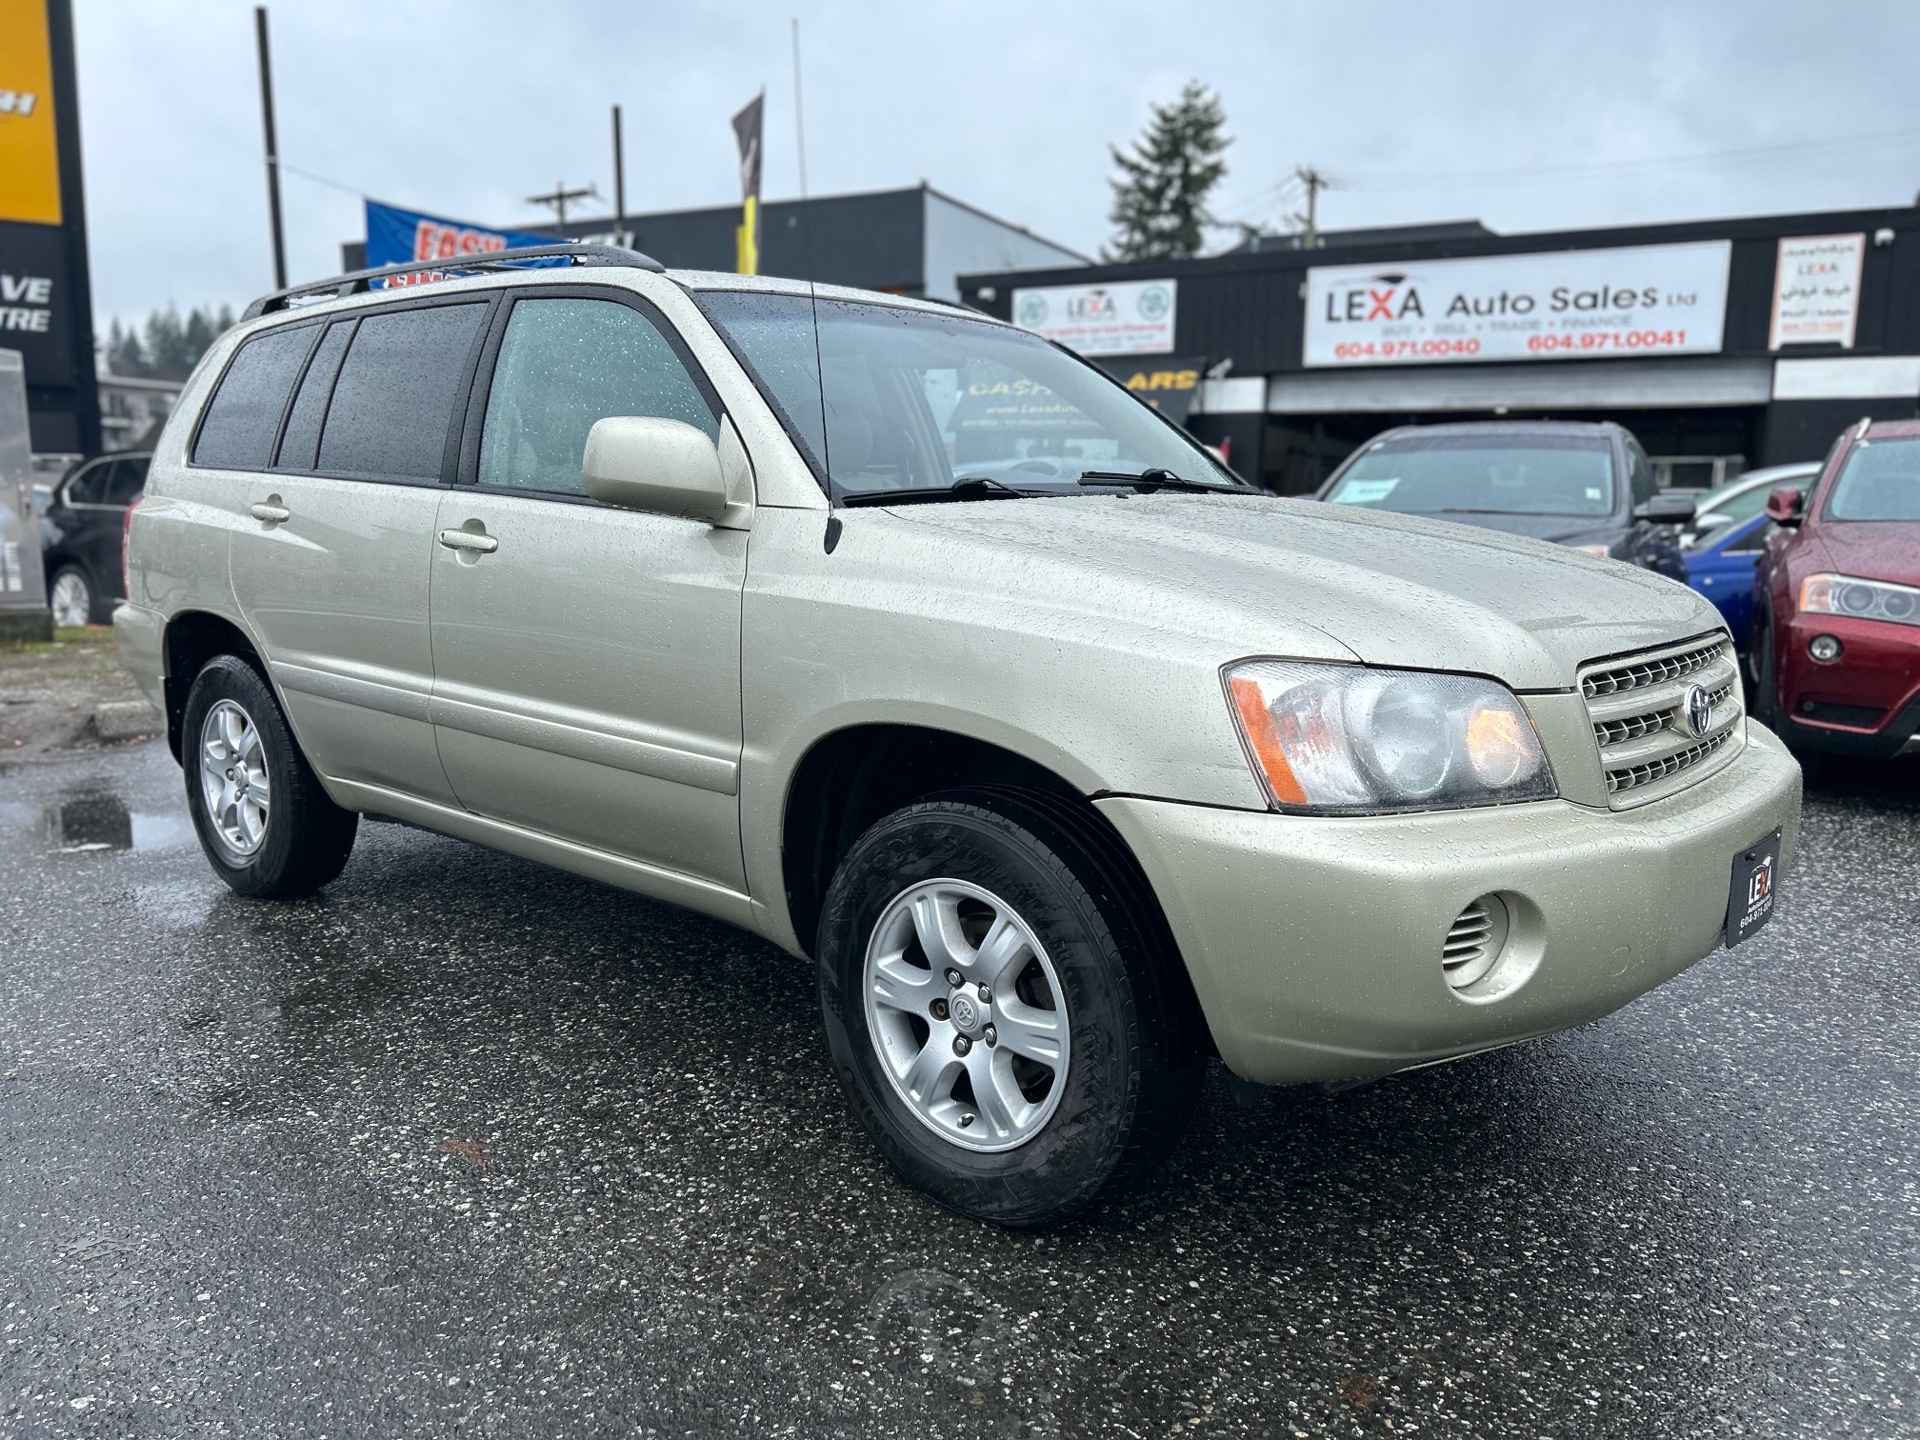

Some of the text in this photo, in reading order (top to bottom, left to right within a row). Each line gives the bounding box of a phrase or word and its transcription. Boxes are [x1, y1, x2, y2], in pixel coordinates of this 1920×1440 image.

[1067, 296, 1117, 319] LEXA
[1327, 285, 1698, 322] LEXA Auto Sales Ltd
[1334, 338, 1481, 358] 604.971.0040
[1527, 329, 1687, 352] 604.971.0041
